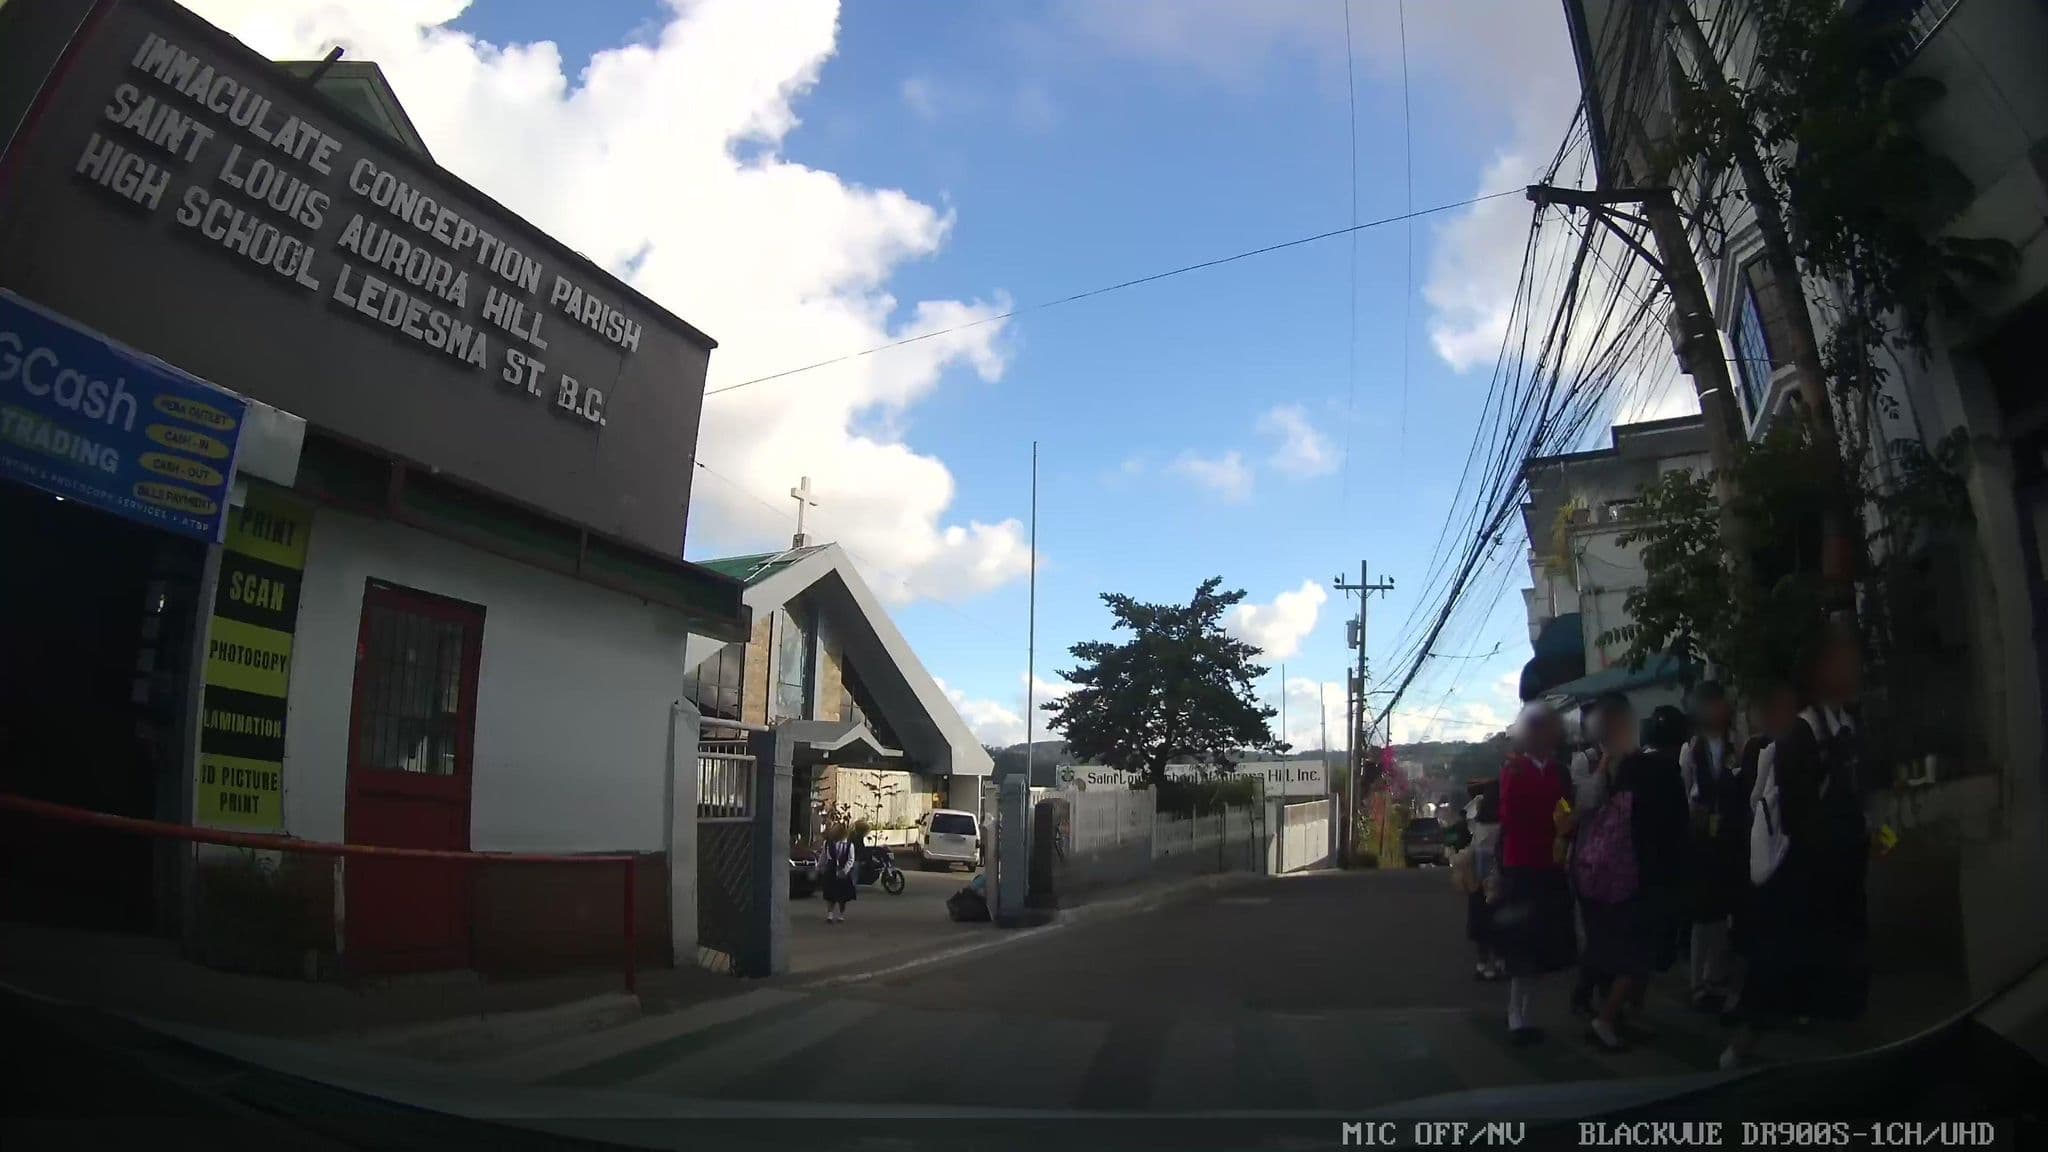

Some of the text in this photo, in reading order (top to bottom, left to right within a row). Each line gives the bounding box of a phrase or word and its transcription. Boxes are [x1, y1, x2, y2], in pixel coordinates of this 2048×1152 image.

[131, 32, 642, 352] IMMACULATE CONCEPTION PARISH
[104, 83, 549, 350] SAINT LOUIS AURORA HILL
[75, 132, 607, 426] HIGH SCHOOL LEDESMA ST. B.C.
[0, 331, 138, 432] GCash
[1, 406, 120, 474] TRADING
[239, 505, 296, 547] PRINT
[230, 570, 285, 612] SCAN
[208, 639, 288, 674] PHOTOCOPY
[202, 711, 282, 738] LAMINATION
[202, 764, 279, 792] ID PICTURE
[1297, 768, 1320, 782] Inc.
[220, 791, 260, 814] PRINT
